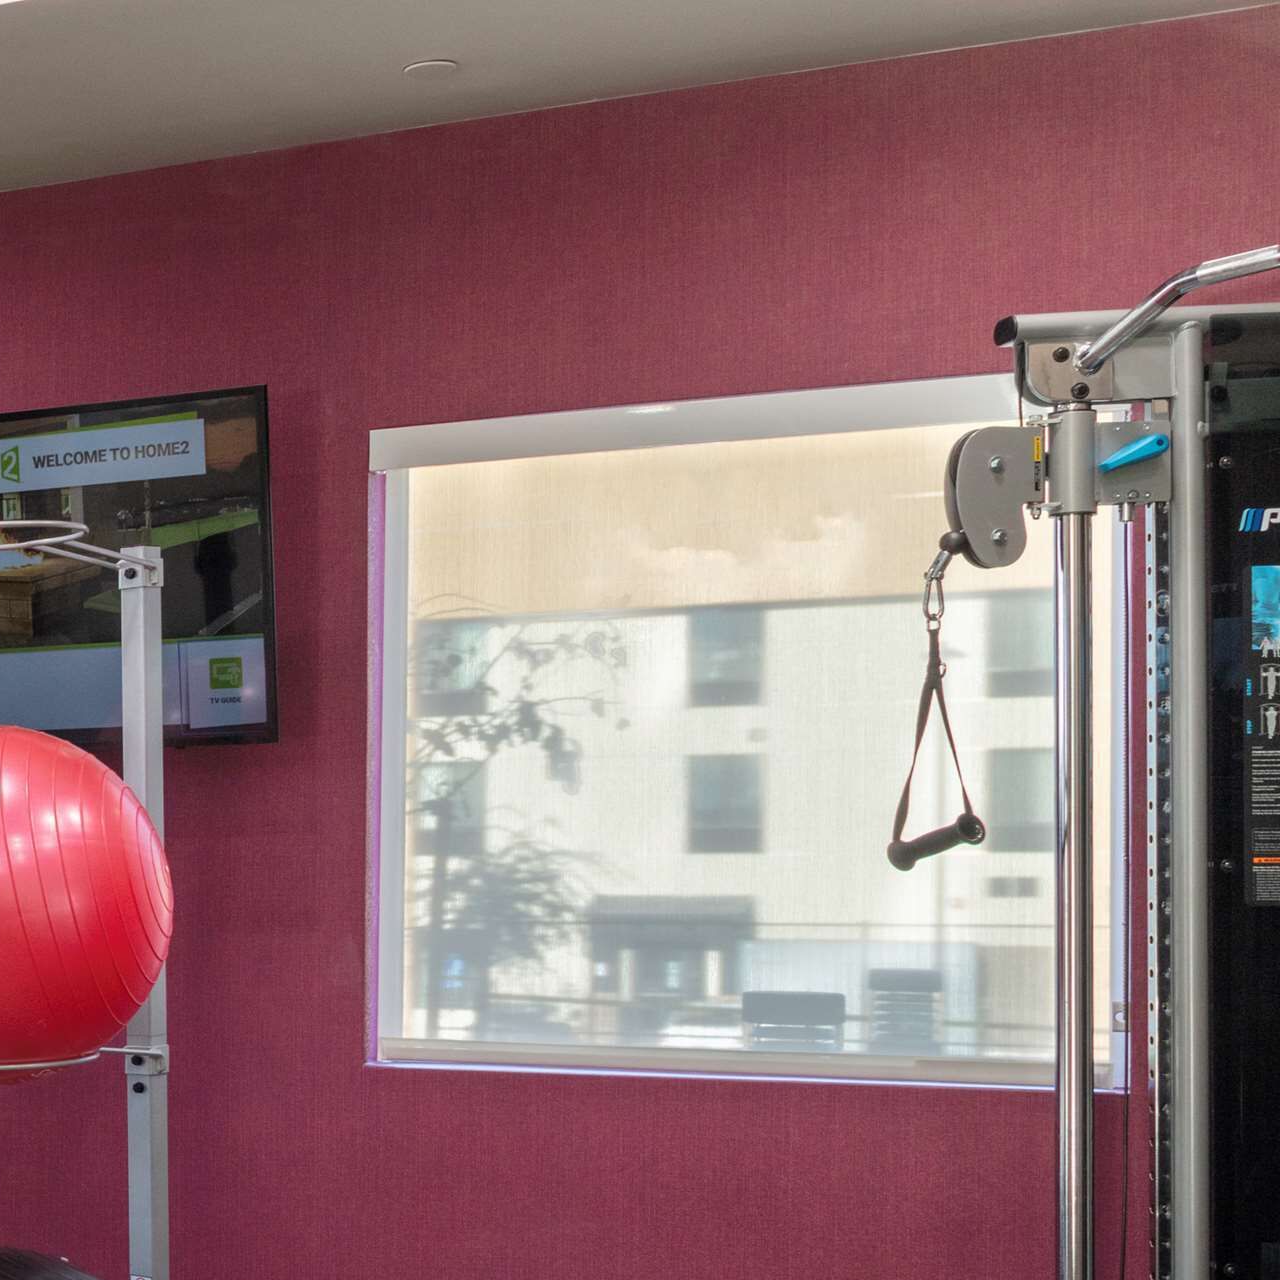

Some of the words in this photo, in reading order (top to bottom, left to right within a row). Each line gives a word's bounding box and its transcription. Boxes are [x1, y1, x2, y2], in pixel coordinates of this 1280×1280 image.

[32, 448, 107, 469] WELCOME
[109, 447, 131, 462] TO
[134, 441, 190, 460] HOME2
